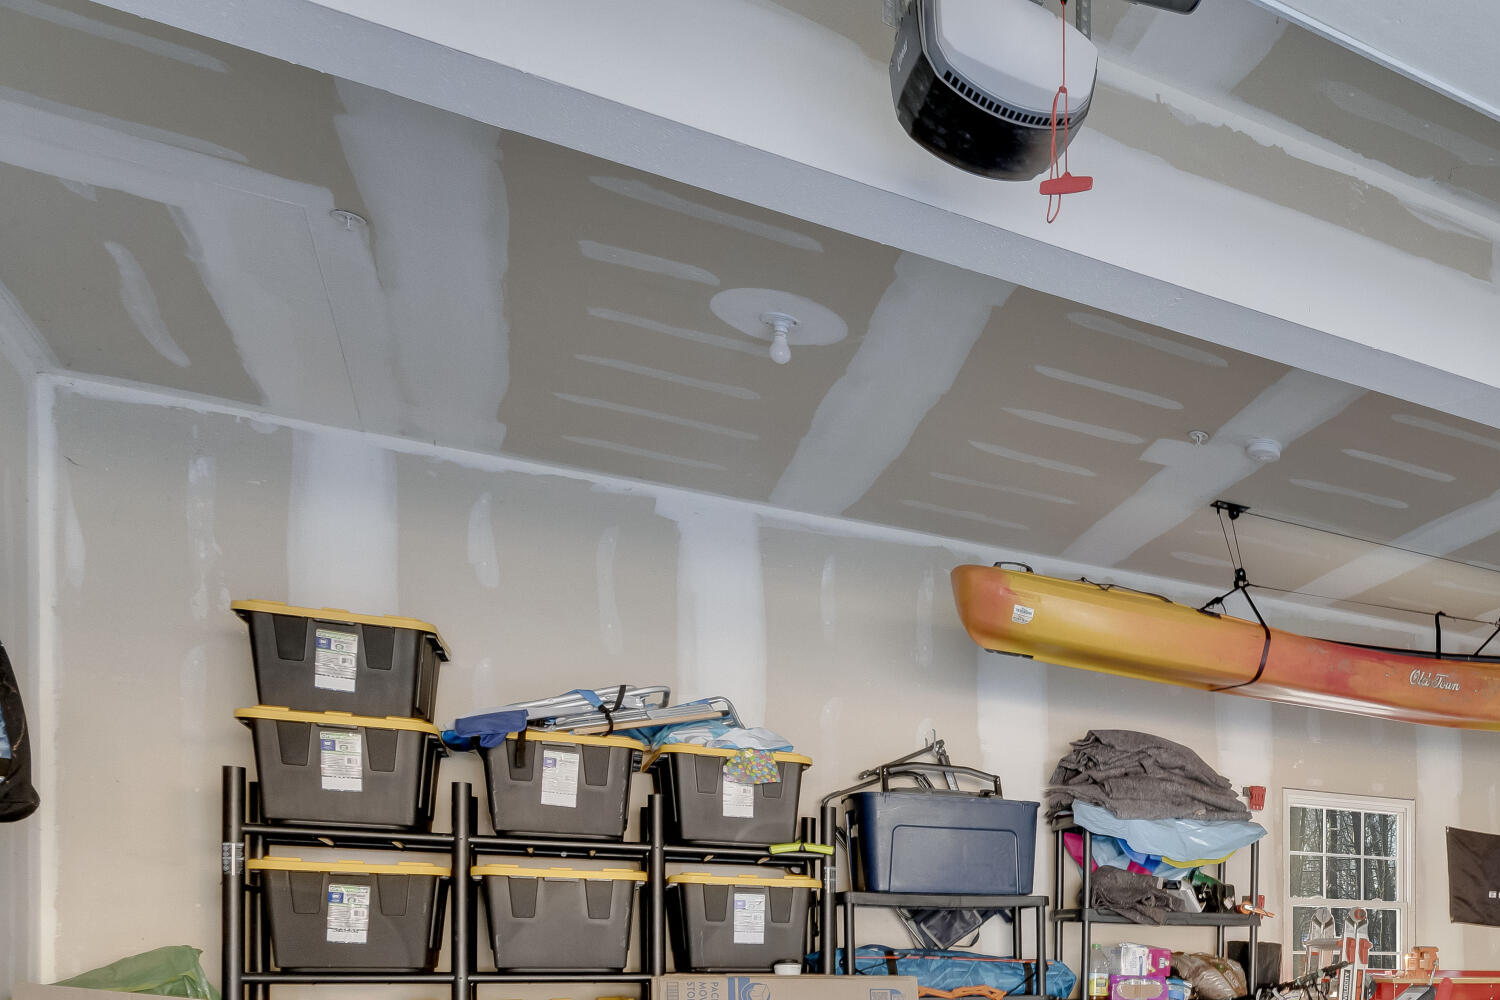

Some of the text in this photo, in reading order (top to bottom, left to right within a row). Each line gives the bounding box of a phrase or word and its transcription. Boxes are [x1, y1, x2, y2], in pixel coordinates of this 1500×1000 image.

[1409, 669, 1460, 691] Old Town
[1342, 972, 1350, 1000] VELOCITY
